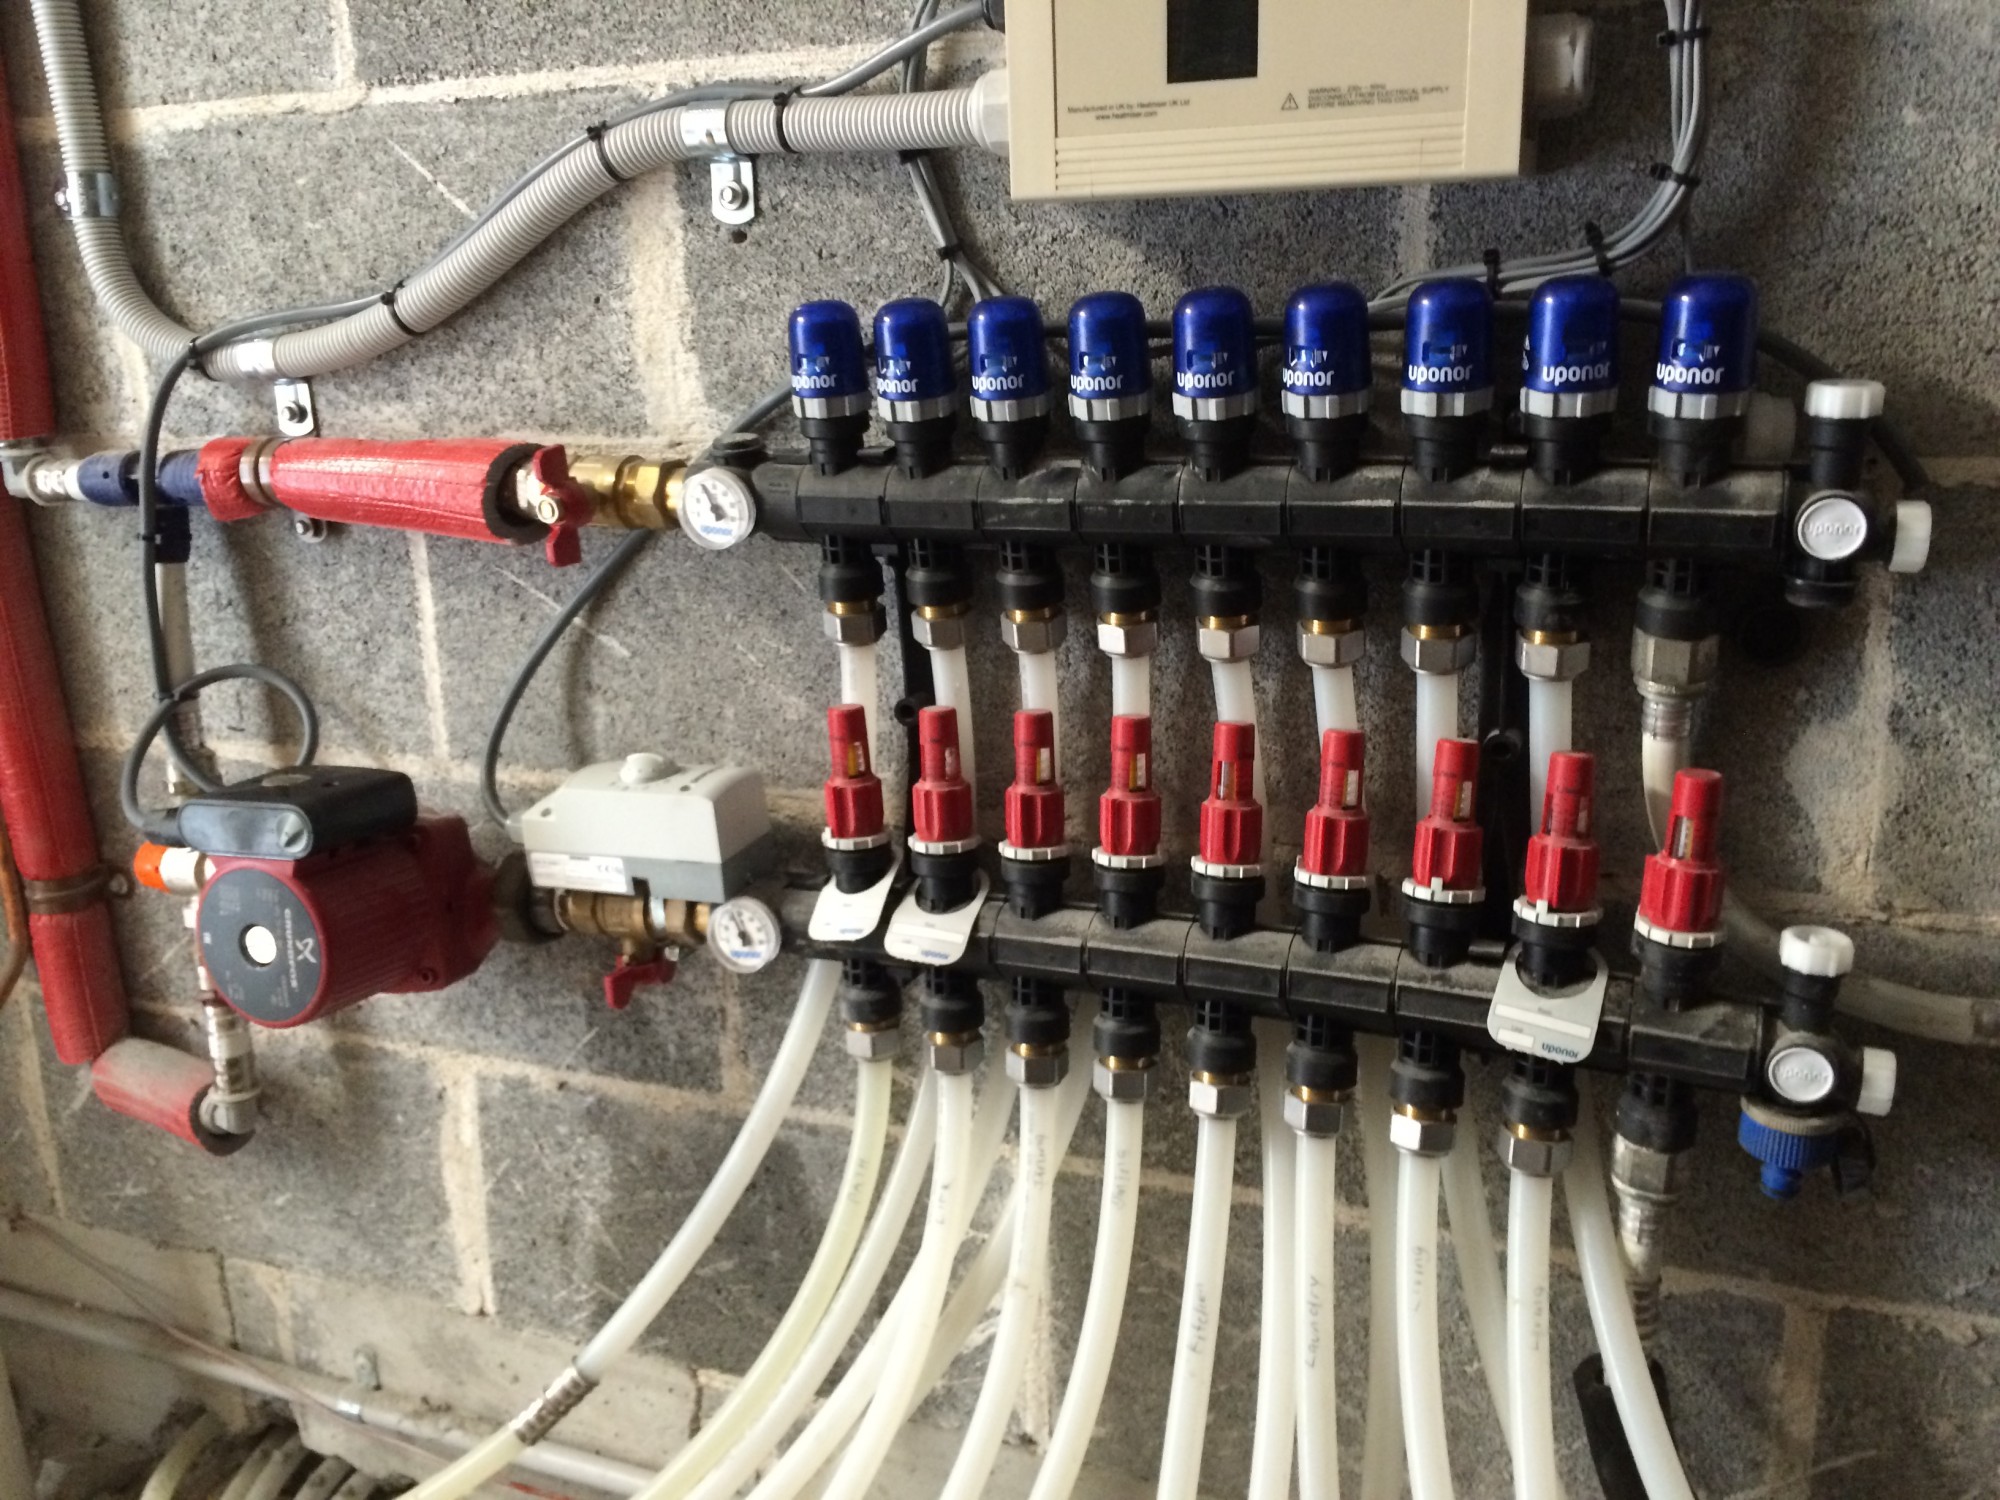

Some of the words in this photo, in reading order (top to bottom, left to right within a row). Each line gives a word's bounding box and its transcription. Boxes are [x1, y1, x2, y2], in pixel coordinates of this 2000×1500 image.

[971, 374, 1024, 394] uponor
[1070, 374, 1124, 394] uponor
[1176, 370, 1235, 392] uponor
[1282, 367, 1335, 387] uponor
[1408, 364, 1473, 386] uponor
[1542, 361, 1611, 386] uponor
[1656, 361, 1725, 386] uponor
[1542, 1042, 1580, 1059] uponor
[1305, 1275, 1328, 1369] Laundry
